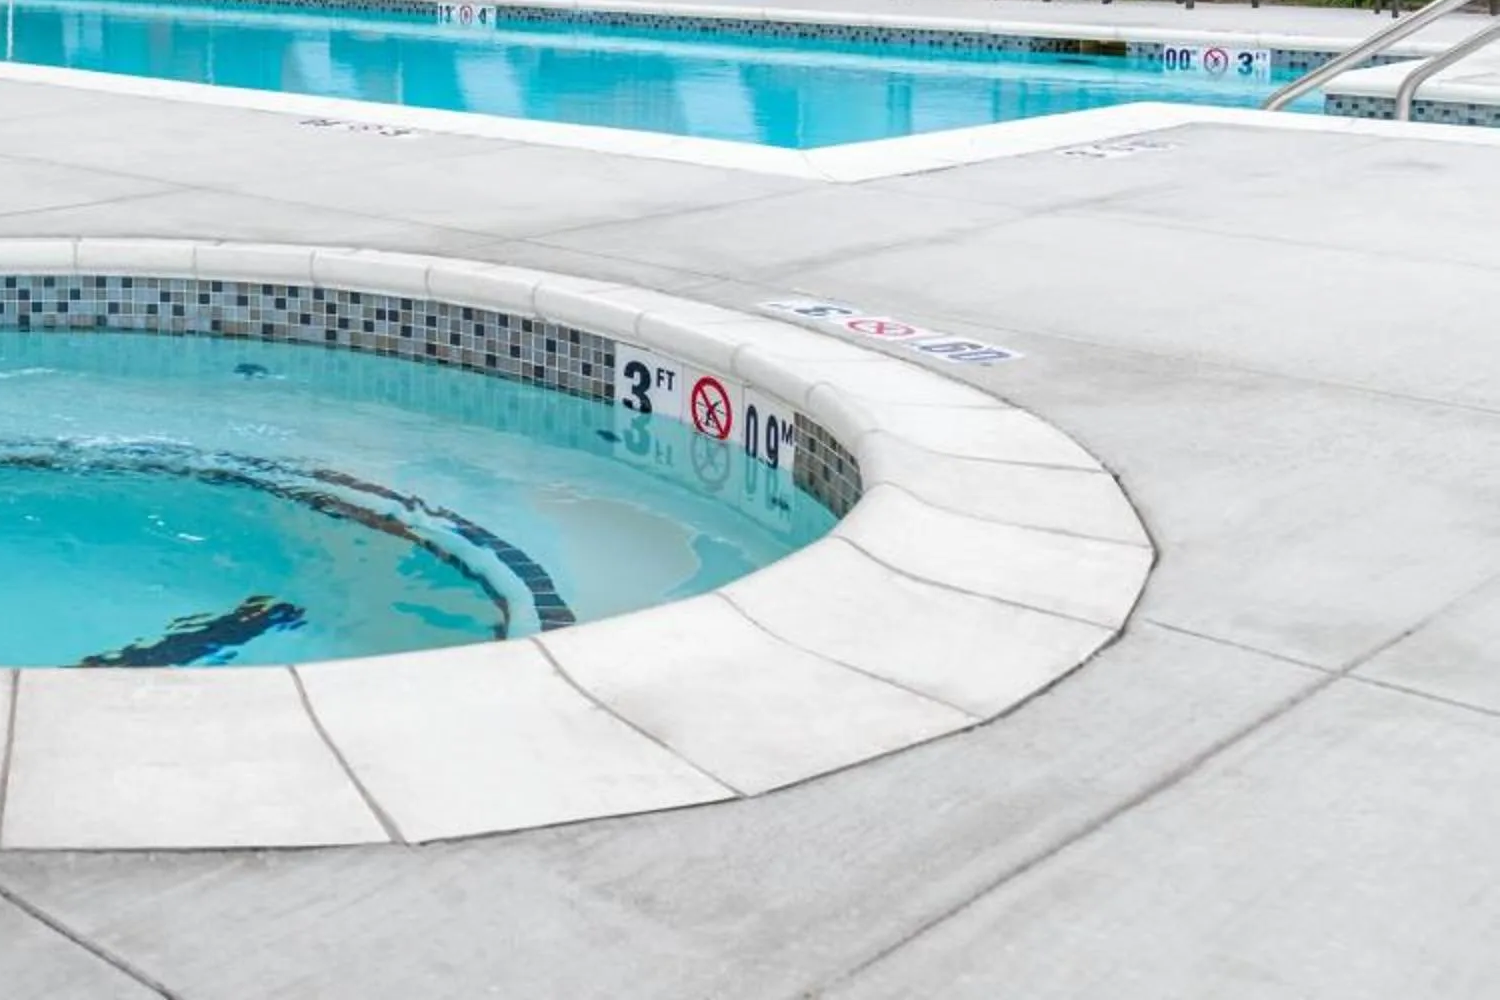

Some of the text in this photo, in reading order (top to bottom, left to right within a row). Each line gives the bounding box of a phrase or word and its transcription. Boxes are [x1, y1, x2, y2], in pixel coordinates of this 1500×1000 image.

[622, 360, 676, 413] 3 FT
[781, 419, 794, 447] M
